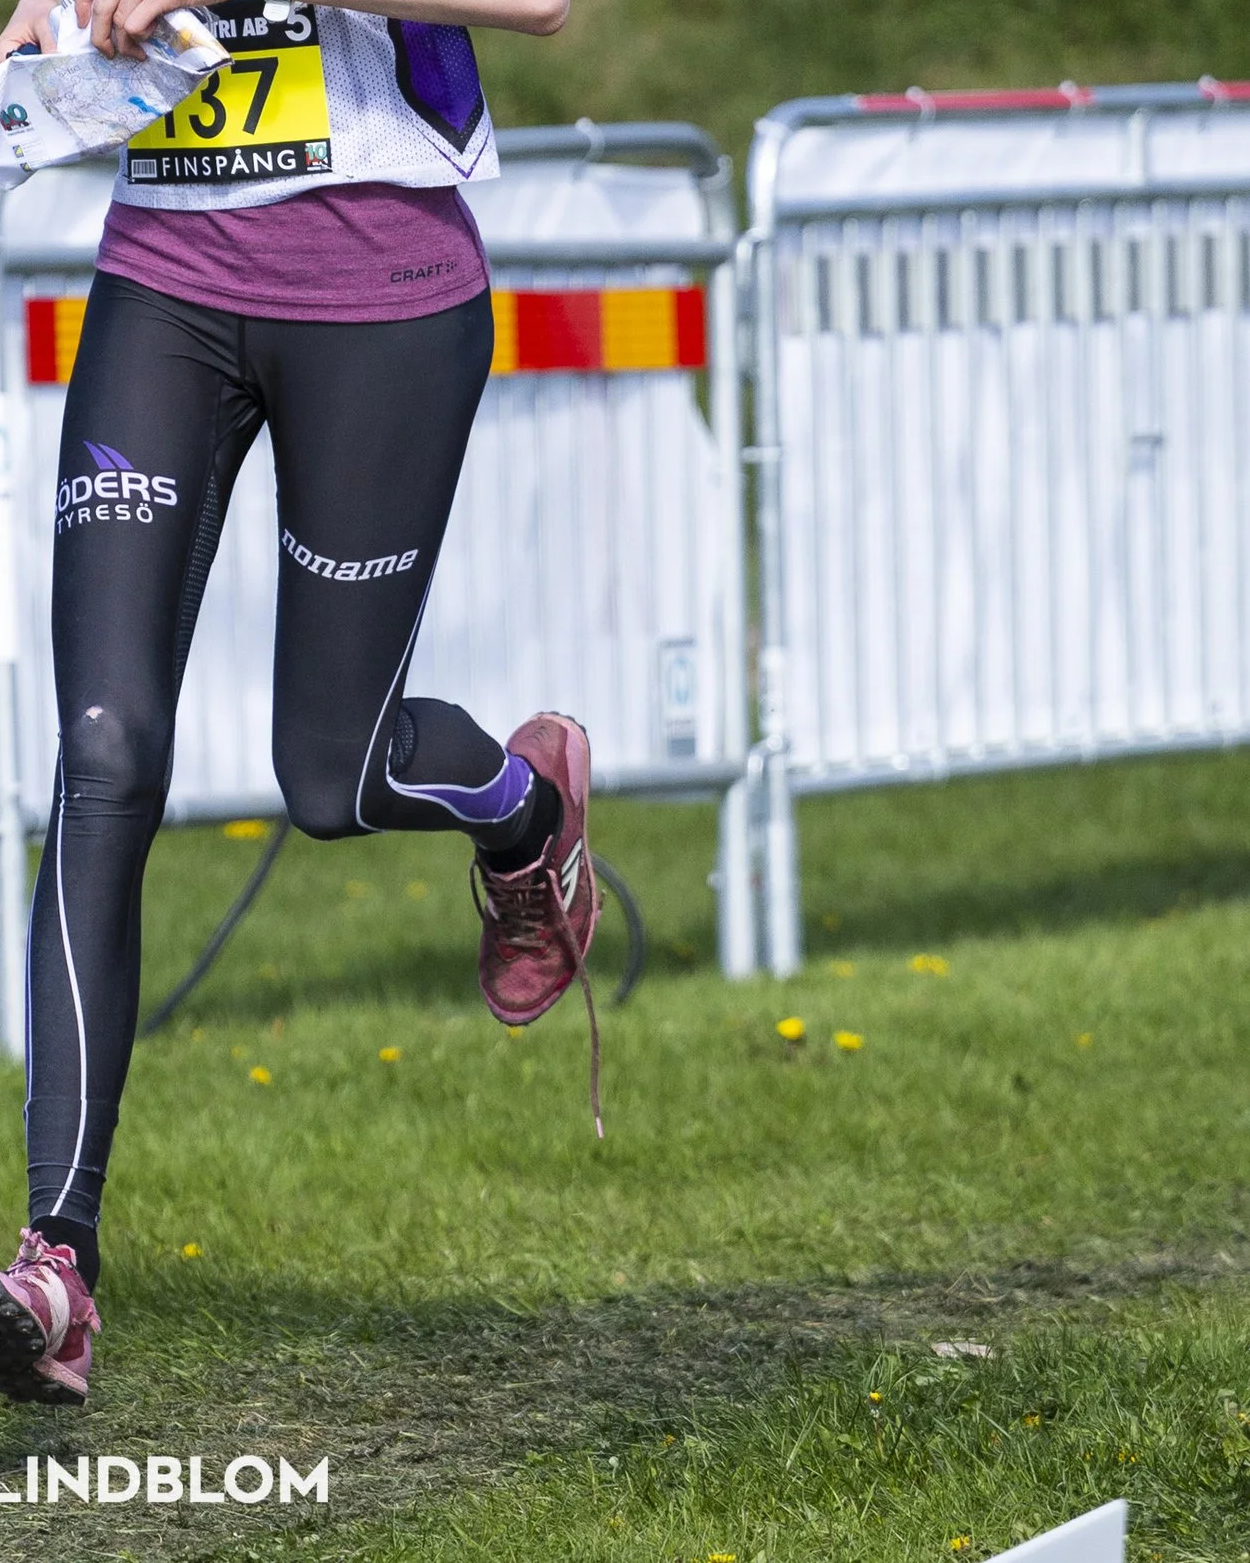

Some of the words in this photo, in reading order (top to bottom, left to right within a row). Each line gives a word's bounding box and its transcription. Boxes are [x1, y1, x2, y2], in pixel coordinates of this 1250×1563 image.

[242, 17, 269, 38] AB
[284, 1, 312, 42] 5
[162, 148, 297, 178] FINSPÅNG
[390, 263, 443, 283] CRAFT
[55, 471, 178, 515] ÖDERS
[57, 502, 154, 535] TYRESÖ
[281, 528, 419, 581] noname
